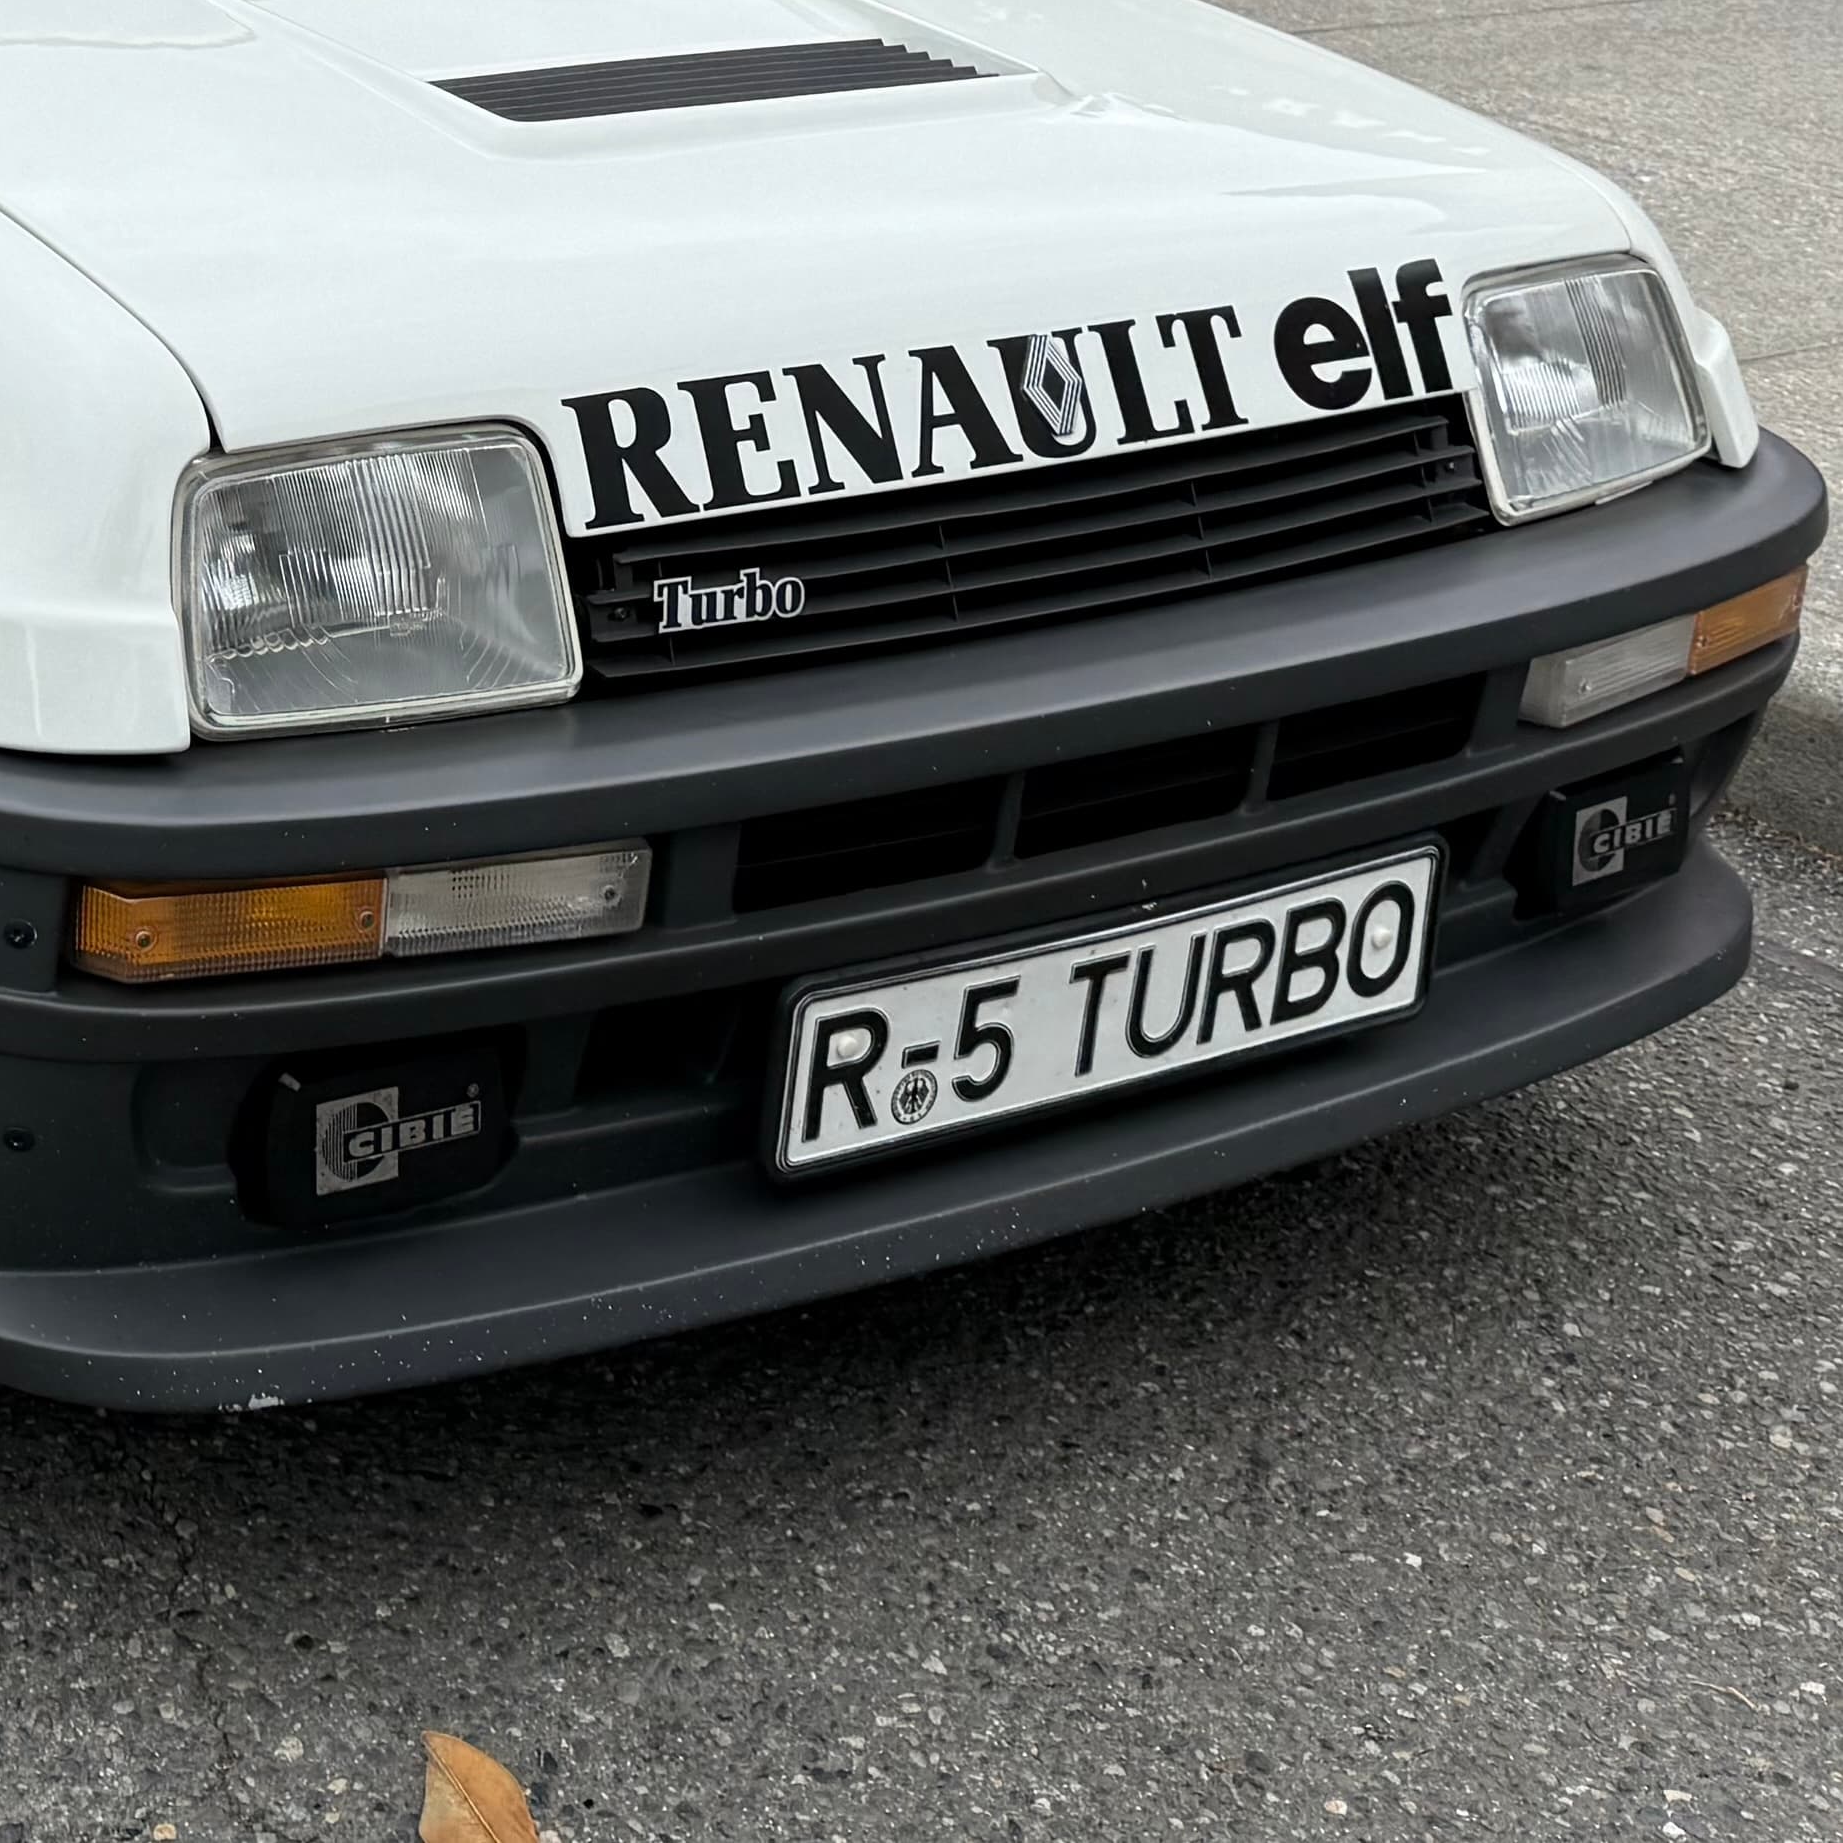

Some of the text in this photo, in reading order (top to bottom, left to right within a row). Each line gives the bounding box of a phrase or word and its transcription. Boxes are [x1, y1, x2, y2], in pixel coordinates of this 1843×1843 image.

[561, 258, 1454, 531] RENAULT elf
[654, 567, 805, 634] Turbo
[801, 879, 1417, 1144] R-5 TURBO
